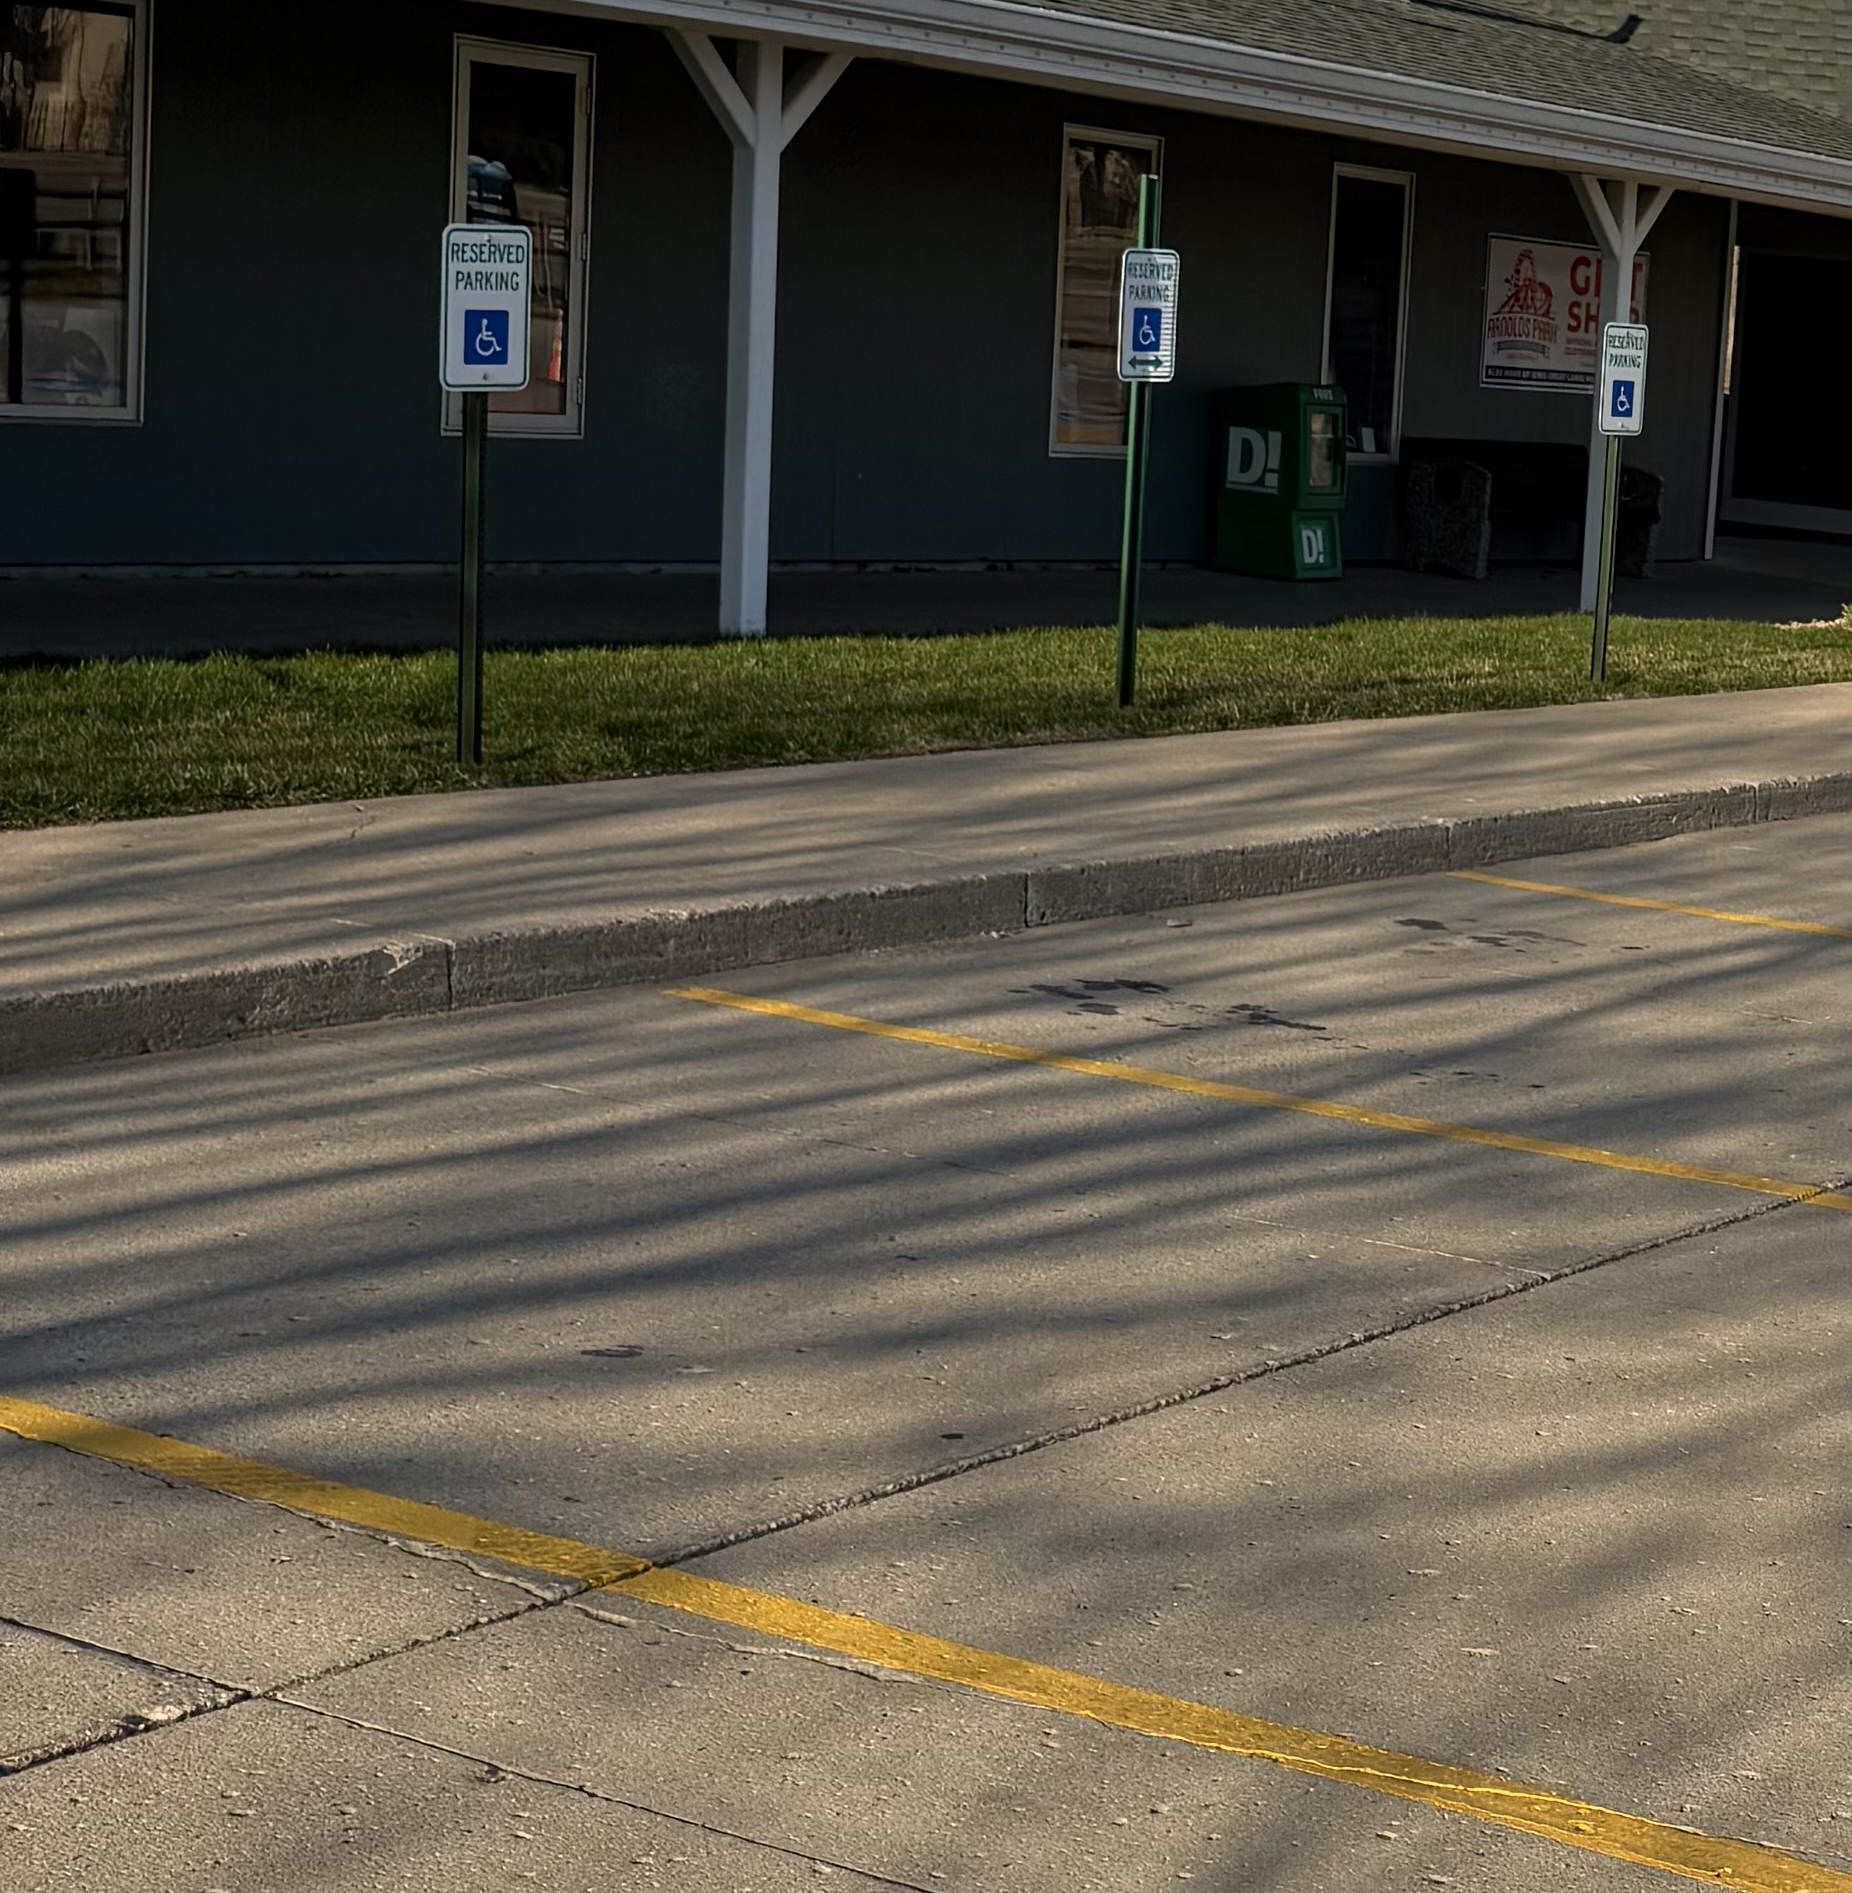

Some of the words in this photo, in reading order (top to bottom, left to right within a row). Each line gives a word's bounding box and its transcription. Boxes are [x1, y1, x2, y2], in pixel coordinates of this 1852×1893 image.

[451, 242, 525, 264] RESERVED
[455, 270, 520, 292] PARKING
[1128, 262, 1174, 281] RESERVED
[1570, 255, 1643, 302] GIT
[1129, 284, 1170, 303] PARKING
